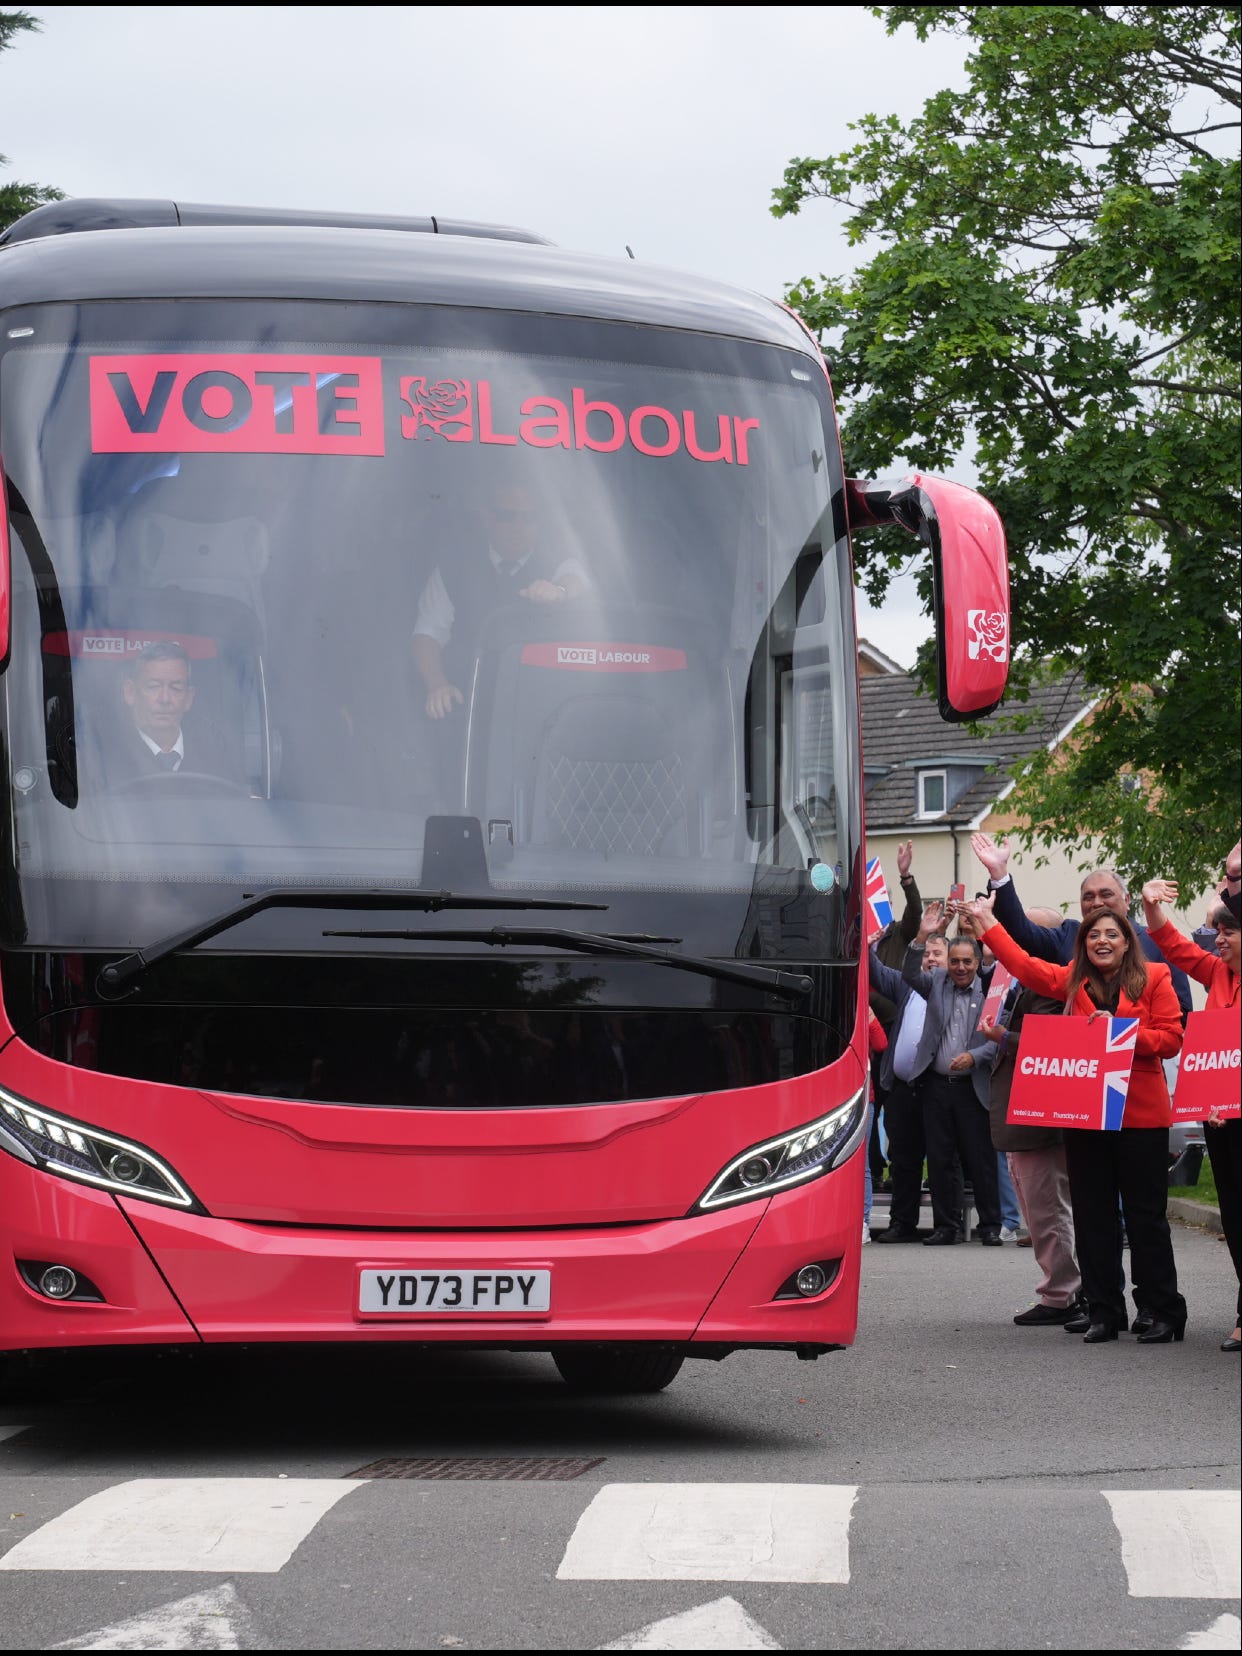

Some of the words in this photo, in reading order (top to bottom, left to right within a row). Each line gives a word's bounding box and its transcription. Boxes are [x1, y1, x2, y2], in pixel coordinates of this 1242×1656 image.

[106, 371, 362, 438] VOTE
[476, 379, 760, 466] Labour
[85, 639, 122, 650] VOTE
[560, 650, 595, 661] VOTE
[600, 652, 650, 664] LABOUR
[1020, 1056, 1099, 1079] CHANGE
[1183, 1048, 1242, 1072] CHANG
[1053, 1111, 1075, 1120] Thursday
[376, 1275, 462, 1306] YD73
[472, 1275, 536, 1306] FPY
